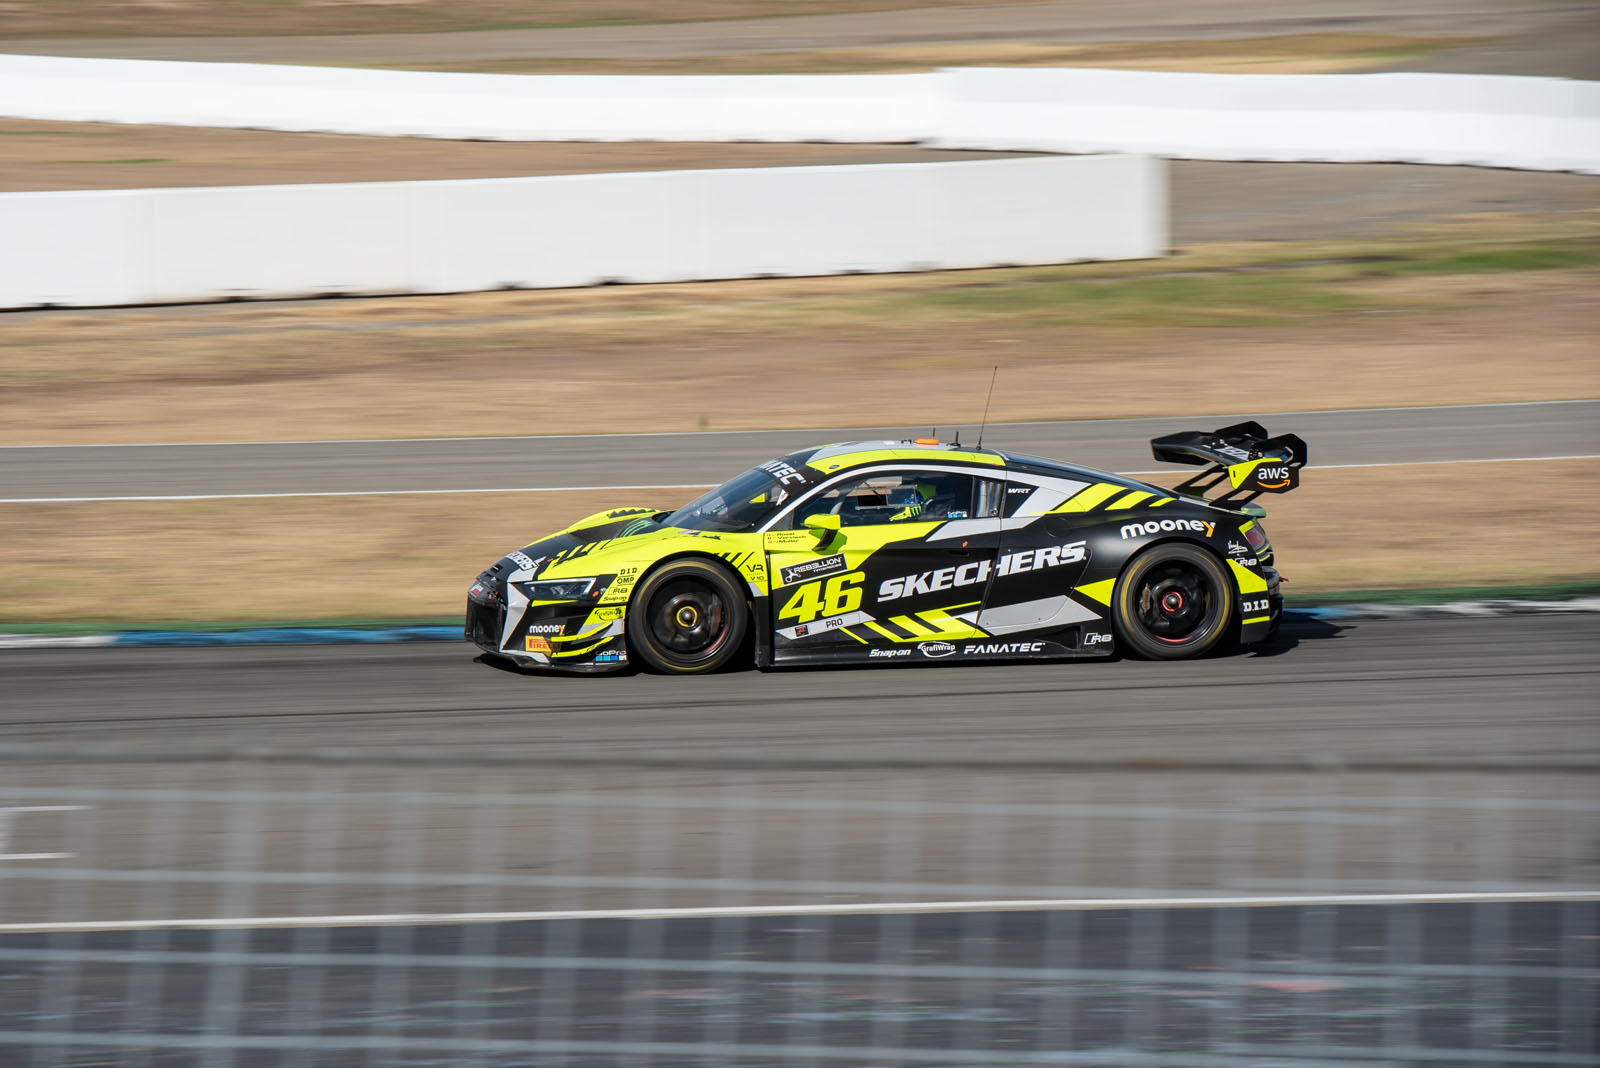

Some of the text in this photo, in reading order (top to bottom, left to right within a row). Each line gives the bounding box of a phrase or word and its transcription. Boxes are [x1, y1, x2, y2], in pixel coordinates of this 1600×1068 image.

[1258, 467, 1289, 480] aws
[1120, 519, 1216, 540] mooney
[746, 564, 764, 573] VR
[793, 557, 842, 573] REBELLION
[877, 540, 1086, 603] SKECHERS
[778, 571, 866, 624] 46
[529, 624, 566, 635] mooney
[825, 618, 844, 629] PRO
[964, 642, 1043, 655] FANATEC
